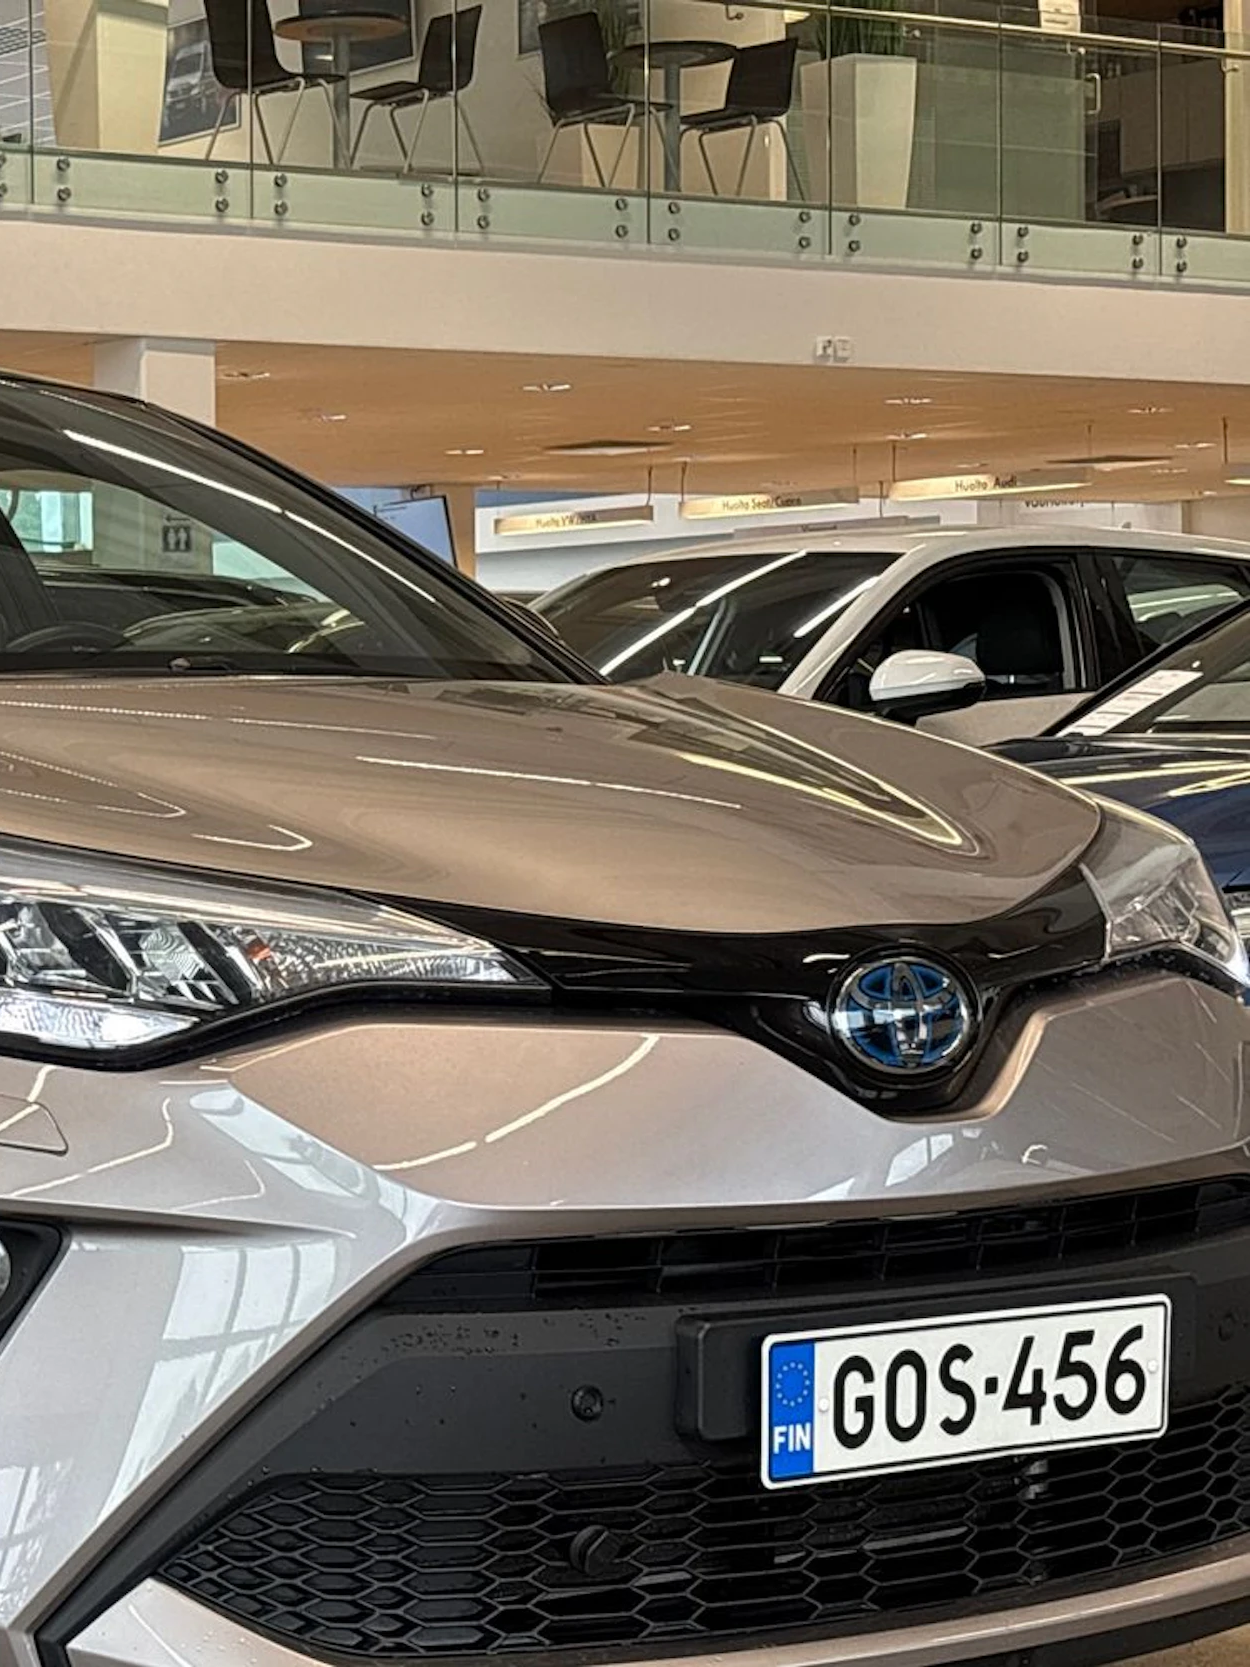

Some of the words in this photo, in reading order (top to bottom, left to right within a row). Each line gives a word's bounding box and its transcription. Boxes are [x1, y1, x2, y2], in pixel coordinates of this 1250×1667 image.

[954, 478, 989, 492] Huolto
[993, 474, 1018, 489] Audi
[722, 500, 750, 511] Huolto
[831, 1324, 1147, 1450] GOS-456
[773, 1422, 812, 1455] FIN
